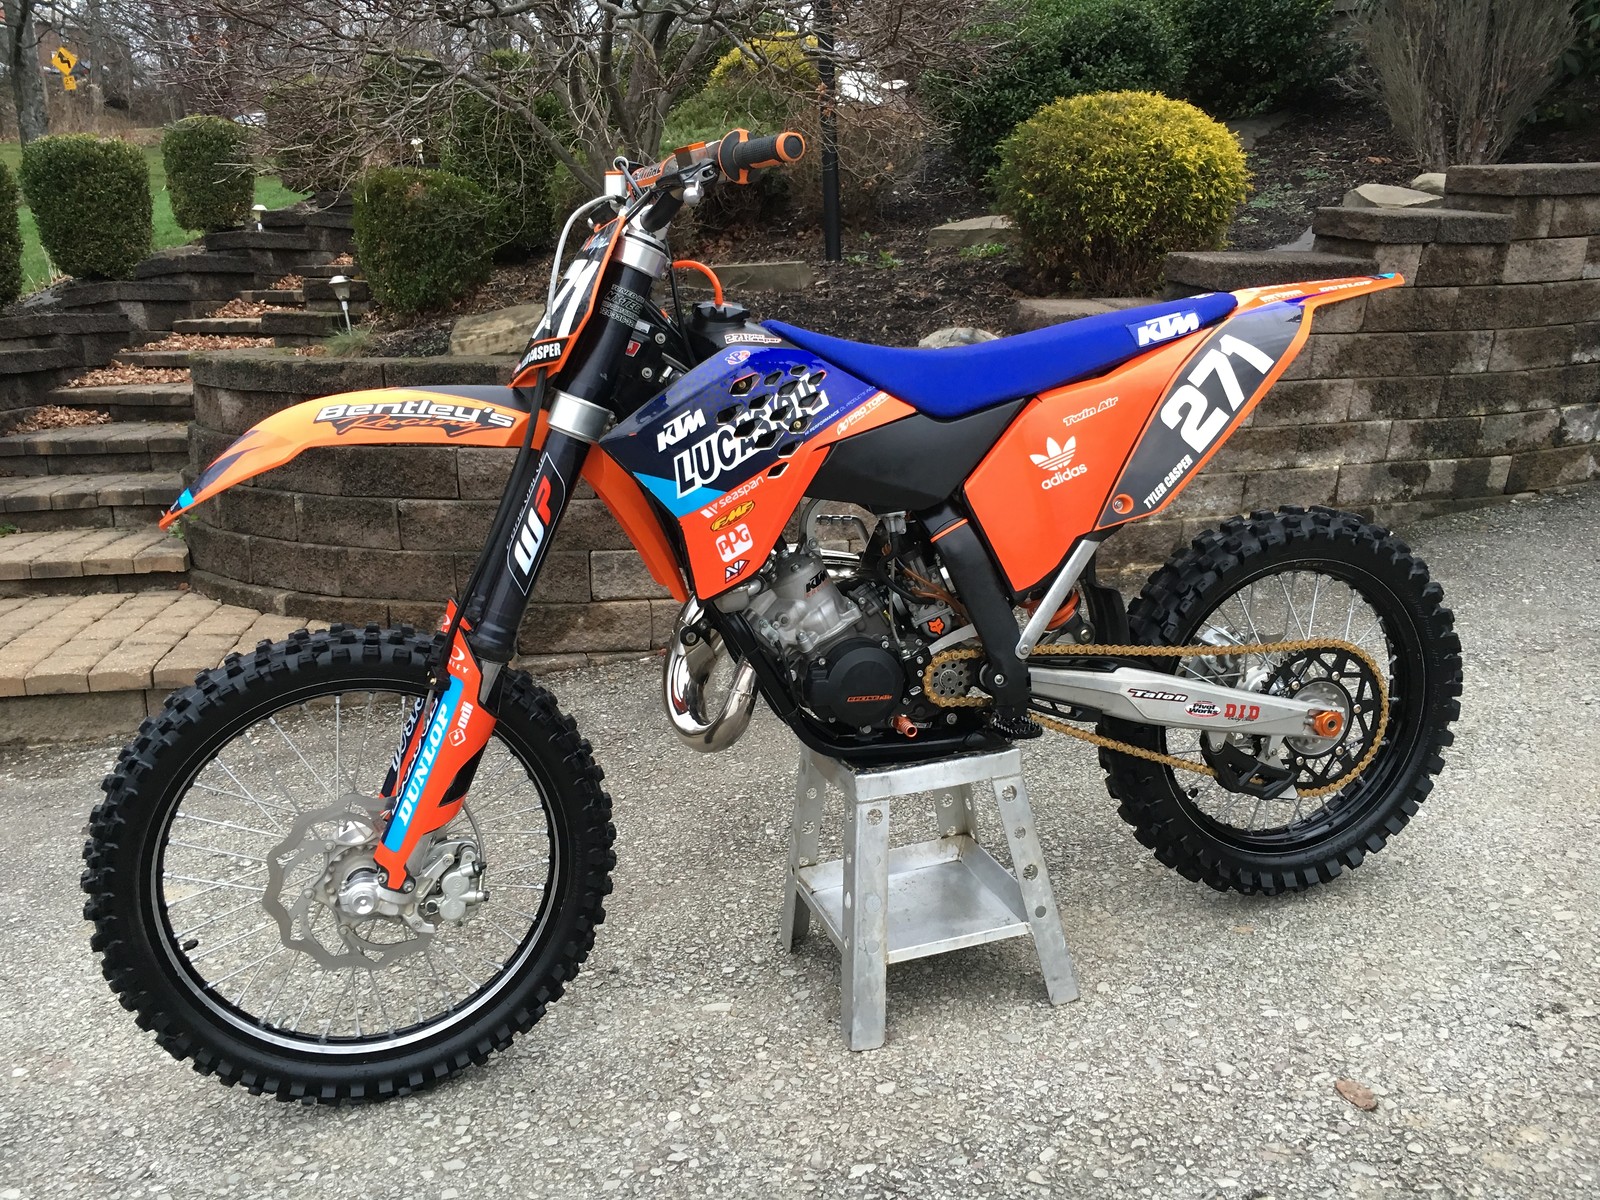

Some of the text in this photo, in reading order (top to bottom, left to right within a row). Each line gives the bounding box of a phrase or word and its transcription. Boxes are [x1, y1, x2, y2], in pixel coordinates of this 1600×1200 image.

[1137, 312, 1200, 348] KTM
[528, 342, 562, 362] CASPER
[1160, 333, 1275, 454] 271
[317, 400, 515, 428] Bentley's
[336, 413, 486, 433] Racing
[809, 409, 840, 432] PERFORMANCE
[848, 406, 867, 423] PRO
[1063, 396, 1119, 427] Twin Air
[656, 408, 706, 453] KTM
[1041, 463, 1088, 490] adidas
[1143, 454, 1194, 510] TYLER CASPER
[718, 475, 765, 509] seaspan
[514, 474, 552, 577] WP
[711, 500, 754, 531] FMF
[716, 526, 752, 558] PPG
[805, 570, 829, 592] KTM
[1128, 688, 1188, 702] Talon
[1193, 702, 1216, 710] Pivot
[457, 701, 474, 730] odi
[1189, 707, 1218, 715] Works
[398, 703, 449, 827] DUNLOP
